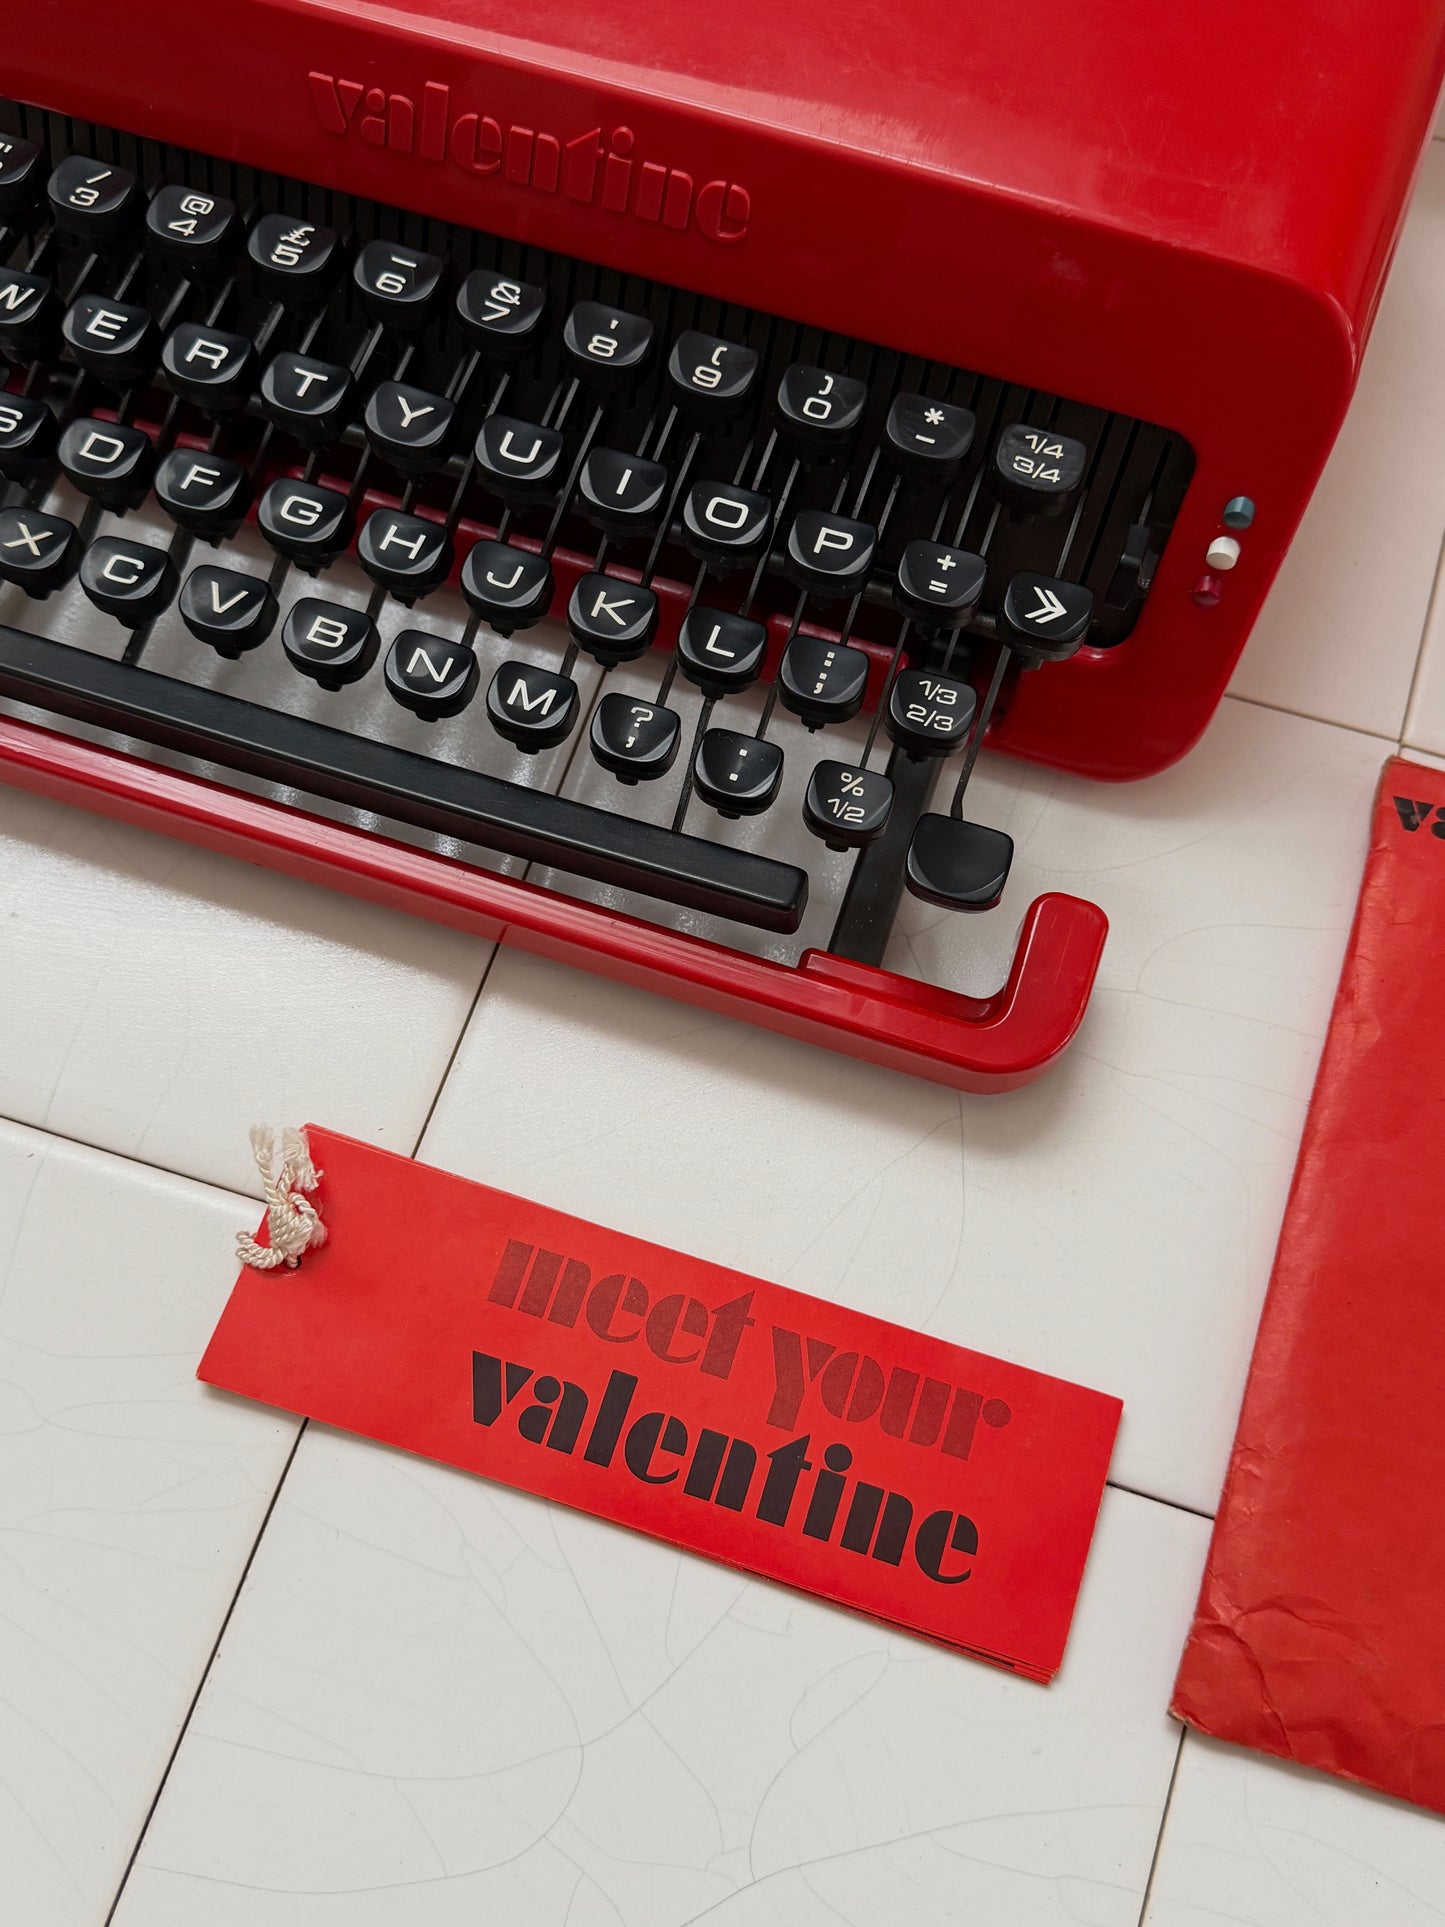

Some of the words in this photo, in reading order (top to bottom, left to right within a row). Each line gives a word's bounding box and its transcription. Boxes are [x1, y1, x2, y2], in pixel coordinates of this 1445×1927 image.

[308, 71, 752, 244] valentine
[69, 187, 100, 206] 3
[180, 194, 215, 216] @
[167, 219, 198, 237] 4
[280, 227, 315, 248] £
[271, 244, 304, 267] 5
[372, 272, 407, 294] 6
[490, 282, 521, 305] &
[86, 308, 129, 340] E
[482, 301, 510, 321] 7
[186, 339, 229, 370] R
[587, 334, 618, 358] 8
[294, 367, 329, 397] T
[692, 363, 722, 388] 9
[397, 395, 435, 428] Y
[78, 431, 125, 463] D
[499, 430, 543, 463] U
[1024, 433, 1063, 460] 1/4
[180, 464, 221, 490] F
[616, 468, 633, 495] I
[1013, 456, 1061, 484] 3/4
[279, 495, 323, 526] G
[705, 496, 749, 529] O
[2, 522, 54, 556] X
[380, 525, 427, 560] H
[813, 526, 854, 554] P
[103, 554, 144, 584] C
[936, 554, 957, 571] +
[486, 565, 524, 589] J
[928, 579, 948, 594] =
[211, 581, 249, 614] V
[590, 591, 635, 625] K
[305, 615, 348, 648] B
[705, 624, 735, 658] L
[406, 648, 454, 683] N
[507, 679, 557, 716] M
[918, 680, 958, 705] 1/3
[630, 706, 654, 728] ?
[906, 703, 954, 731] 2/3
[840, 772, 865, 797] %
[828, 797, 865, 823] 1/2
[487, 1239, 756, 1380] meet
[765, 1325, 1012, 1461] your
[471, 1350, 979, 1584] valentine
